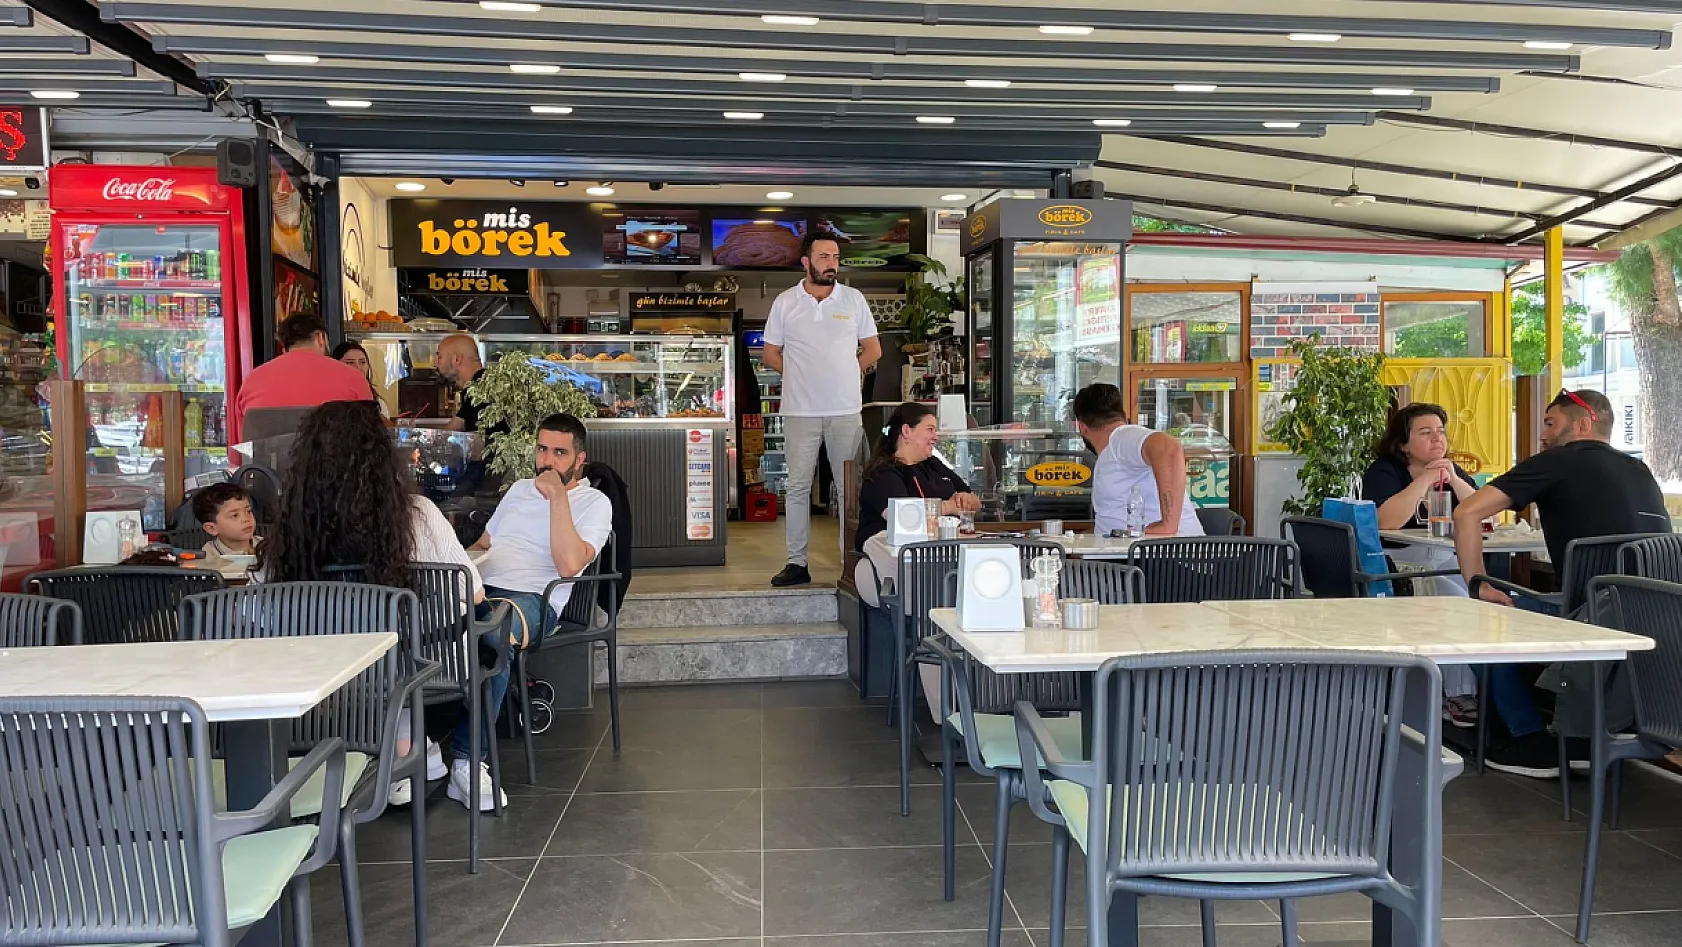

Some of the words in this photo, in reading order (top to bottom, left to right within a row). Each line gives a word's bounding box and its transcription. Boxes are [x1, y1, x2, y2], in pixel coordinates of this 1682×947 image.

[103, 177, 177, 201] Coca-Cola
[483, 207, 532, 228] mis
[1045, 210, 1085, 222] börek
[418, 219, 571, 256] börek
[462, 268, 488, 277] mis
[427, 272, 509, 292] börek
[636, 296, 655, 308] gün
[658, 294, 694, 306] bizimle
[697, 294, 729, 308] başlar
[1034, 468, 1084, 480] börek
